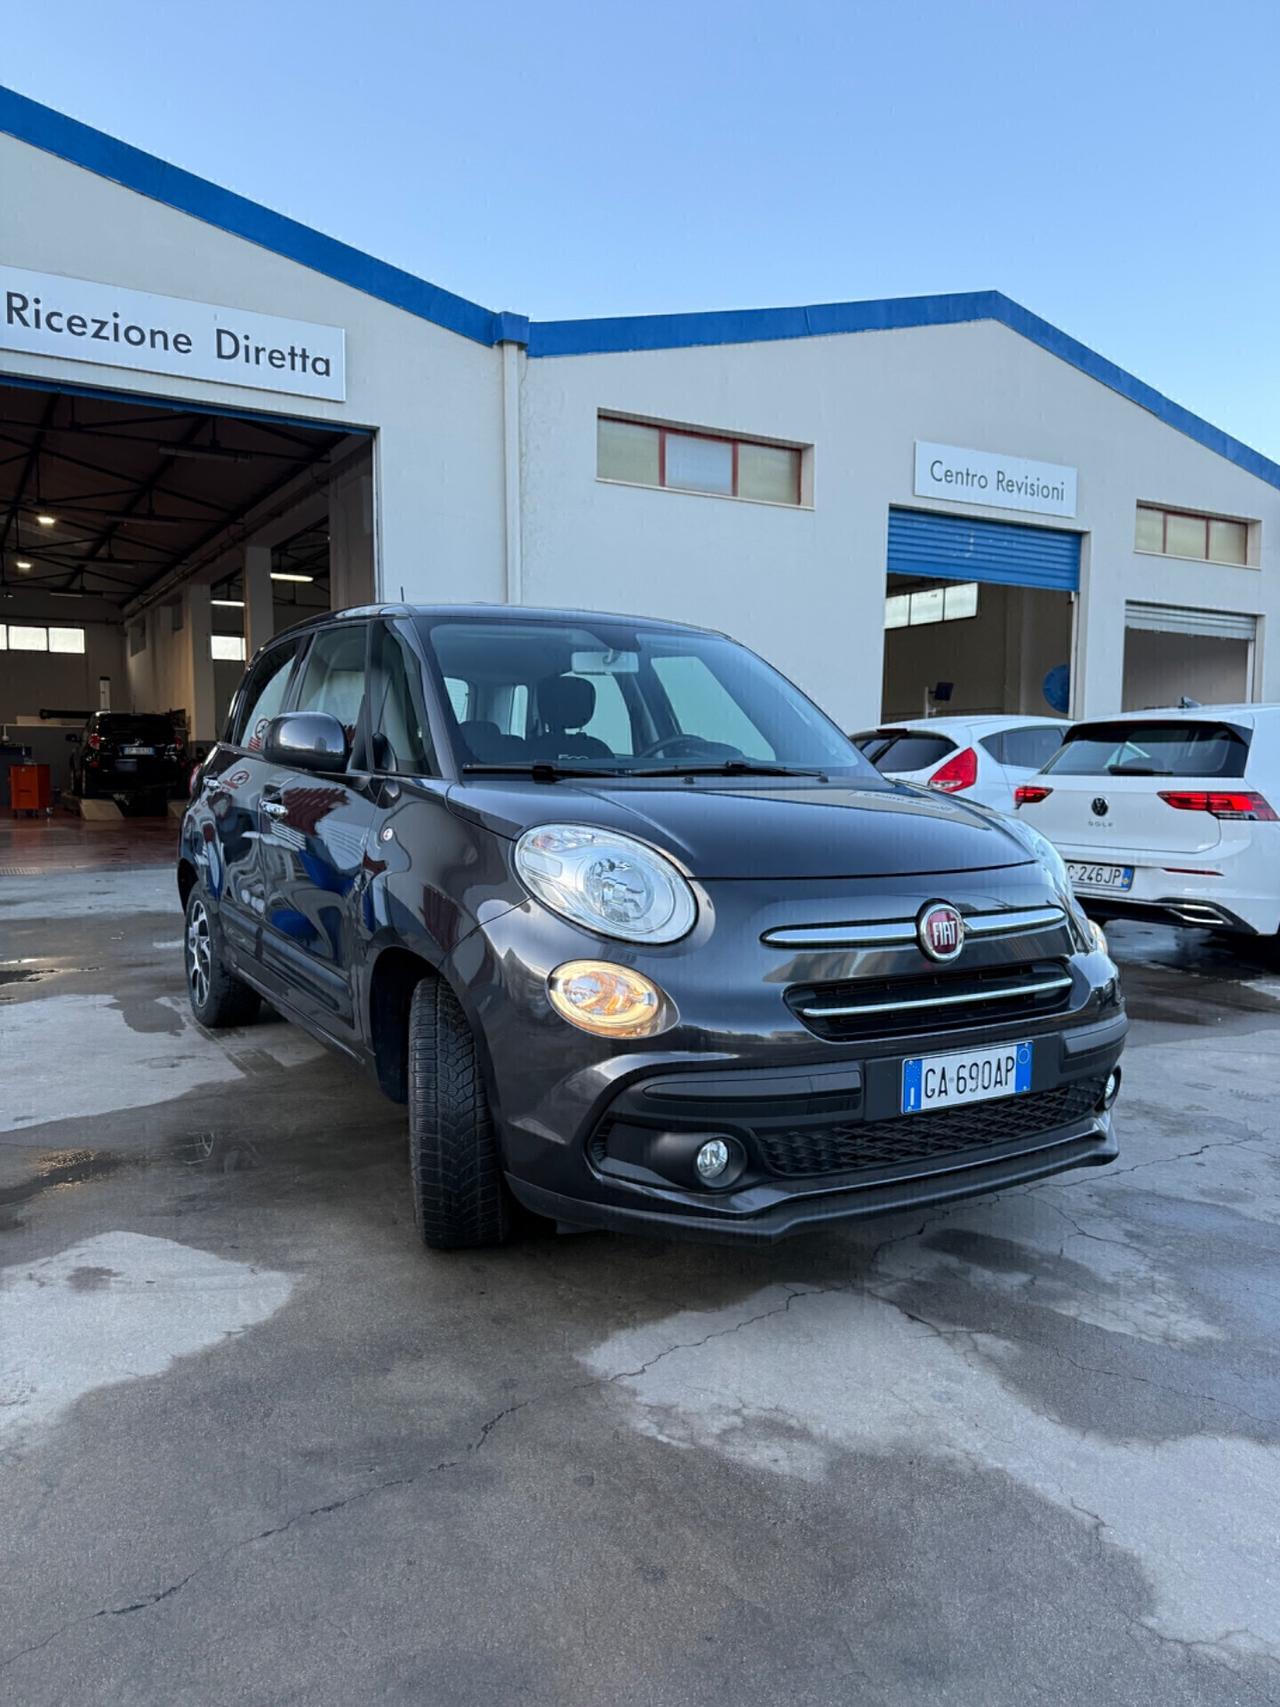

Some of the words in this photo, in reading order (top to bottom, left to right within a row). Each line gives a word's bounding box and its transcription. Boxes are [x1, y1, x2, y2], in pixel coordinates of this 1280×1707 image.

[6, 290, 193, 355] Ricezione
[215, 328, 331, 378] Diretta
[930, 460, 988, 489] Centro
[996, 470, 1065, 501] Revisioni
[1078, 865, 1121, 885] 246JP
[932, 920, 956, 947] FIAT
